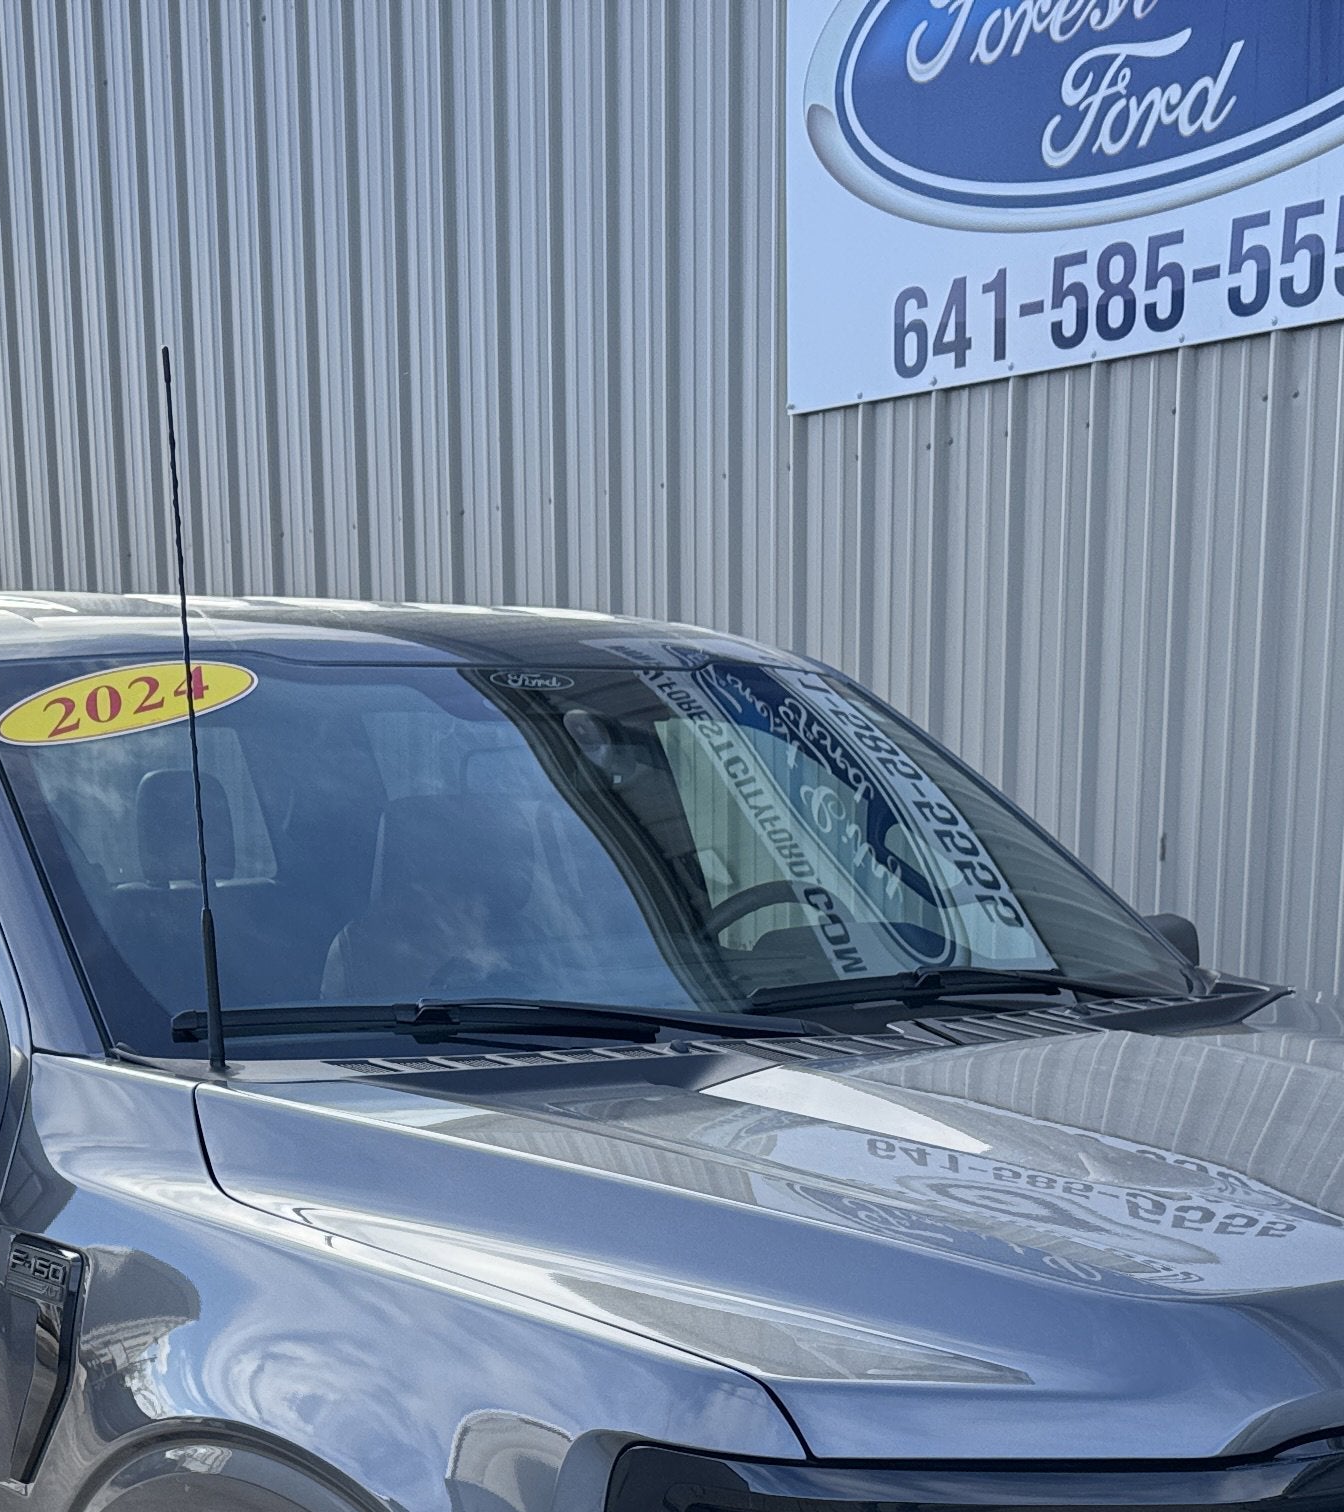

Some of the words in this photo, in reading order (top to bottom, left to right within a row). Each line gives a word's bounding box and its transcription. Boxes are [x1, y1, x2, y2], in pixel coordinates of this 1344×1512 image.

[1041, 27, 1245, 168] Ford
[42, 665, 210, 739] 2024
[8, 1248, 66, 1285] F-150
